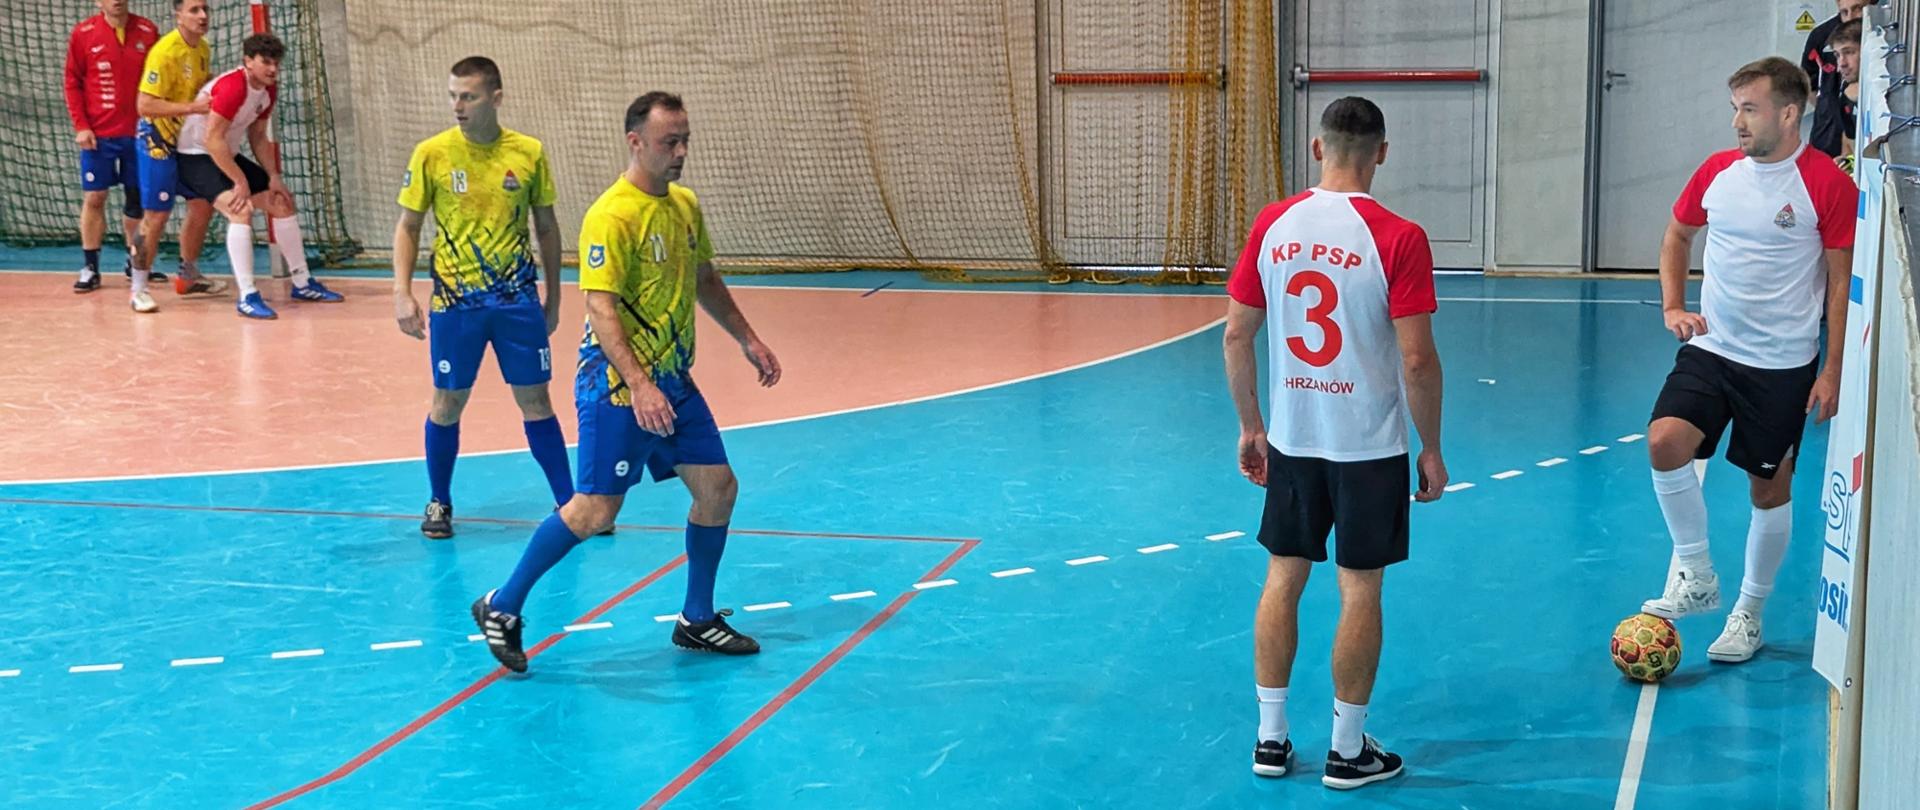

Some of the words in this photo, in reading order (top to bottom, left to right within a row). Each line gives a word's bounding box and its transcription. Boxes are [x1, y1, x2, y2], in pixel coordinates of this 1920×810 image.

[451, 170, 468, 193] 13
[650, 233, 668, 263] 11
[1271, 242, 1302, 264] KP
[1311, 244, 1362, 270] PSP
[1286, 270, 1343, 367] 3
[1283, 376, 1354, 394] HRZANÓW
